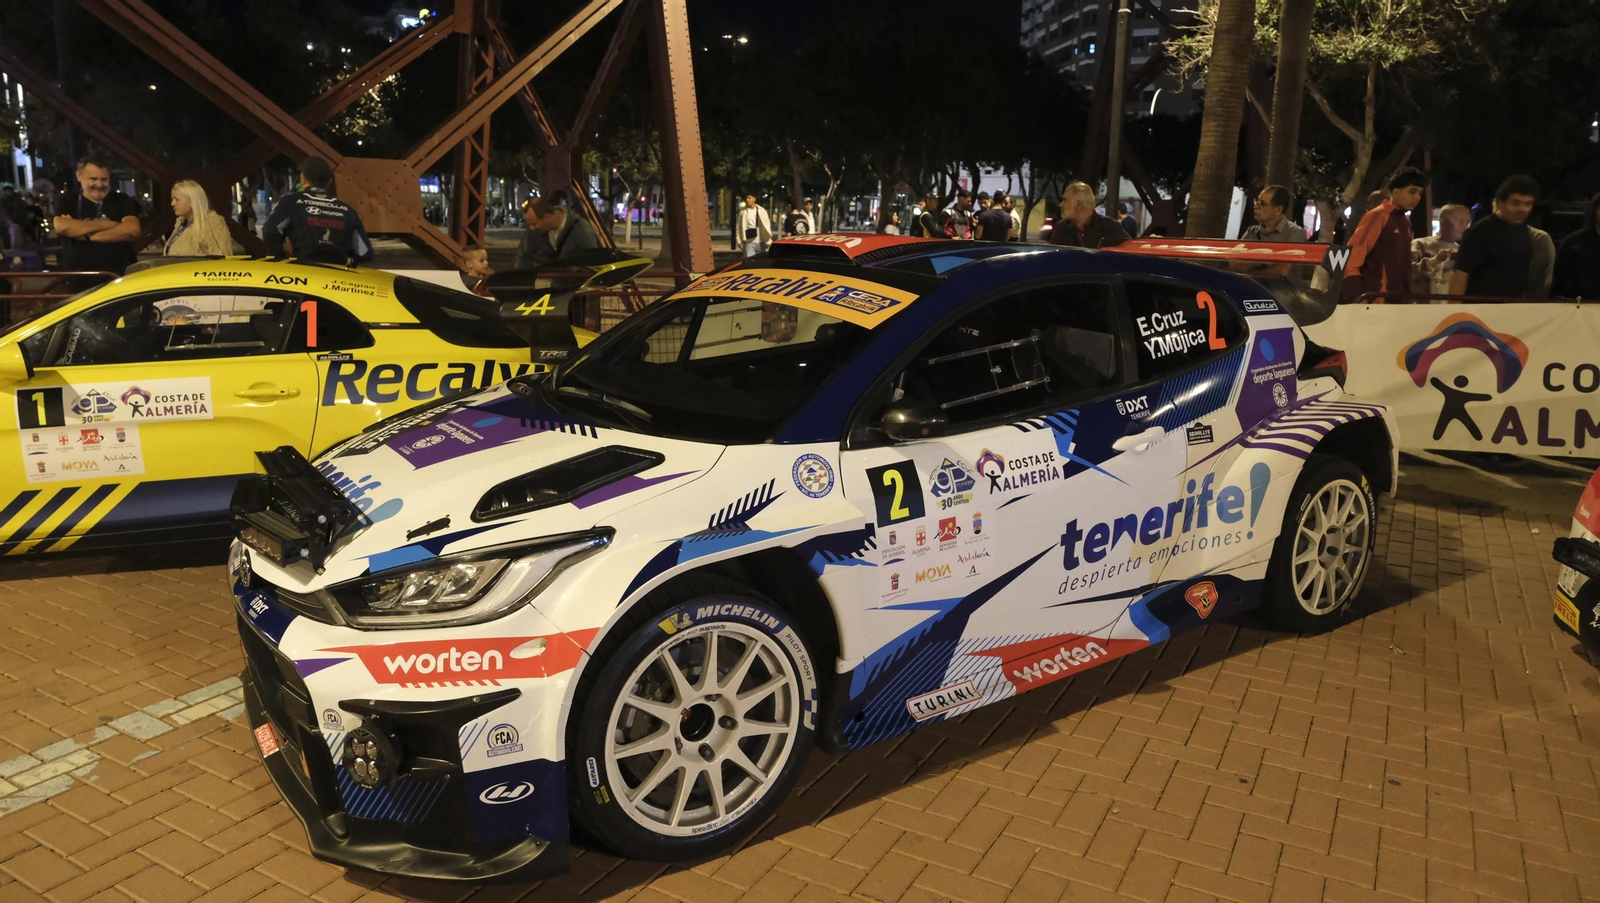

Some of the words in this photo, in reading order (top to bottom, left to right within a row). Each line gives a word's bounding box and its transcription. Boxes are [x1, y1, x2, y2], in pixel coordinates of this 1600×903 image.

[1328, 249, 1350, 271] W
[263, 274, 308, 286] AON
[716, 273, 835, 300] Recalvi
[300, 301, 318, 348] 1
[1136, 310, 1187, 338] E.Cruz
[1196, 291, 1228, 350] 2
[65, 328, 82, 365] CAGIAO
[1253, 371, 1274, 385] deporte
[1273, 367, 1295, 381] lagunero
[31, 391, 48, 426] 1
[145, 402, 208, 418] ALMERÍA
[154, 394, 190, 404] COSTA
[191, 392, 206, 401] DE
[1125, 395, 1148, 412] DXT
[1130, 410, 1151, 421] TENERIFE
[61, 460, 100, 472] MOYA
[1008, 456, 1042, 471] COSTA
[1042, 451, 1056, 463] DE
[1003, 464, 1060, 492] ALMERÍA
[882, 469, 910, 521] 2
[941, 496, 953, 511] 30
[1148, 530, 1243, 565] emociones
[914, 563, 952, 583] MOYA
[1058, 556, 1142, 596] despierta
[253, 598, 270, 614] DXT
[696, 604, 781, 630] MICHELIN
[383, 647, 504, 675] worten
[785, 633, 802, 653] PILOT
[799, 655, 813, 682] SPORT
[1012, 641, 1108, 683] worten
[913, 684, 975, 716] TURINI
[495, 731, 512, 745] FCA
